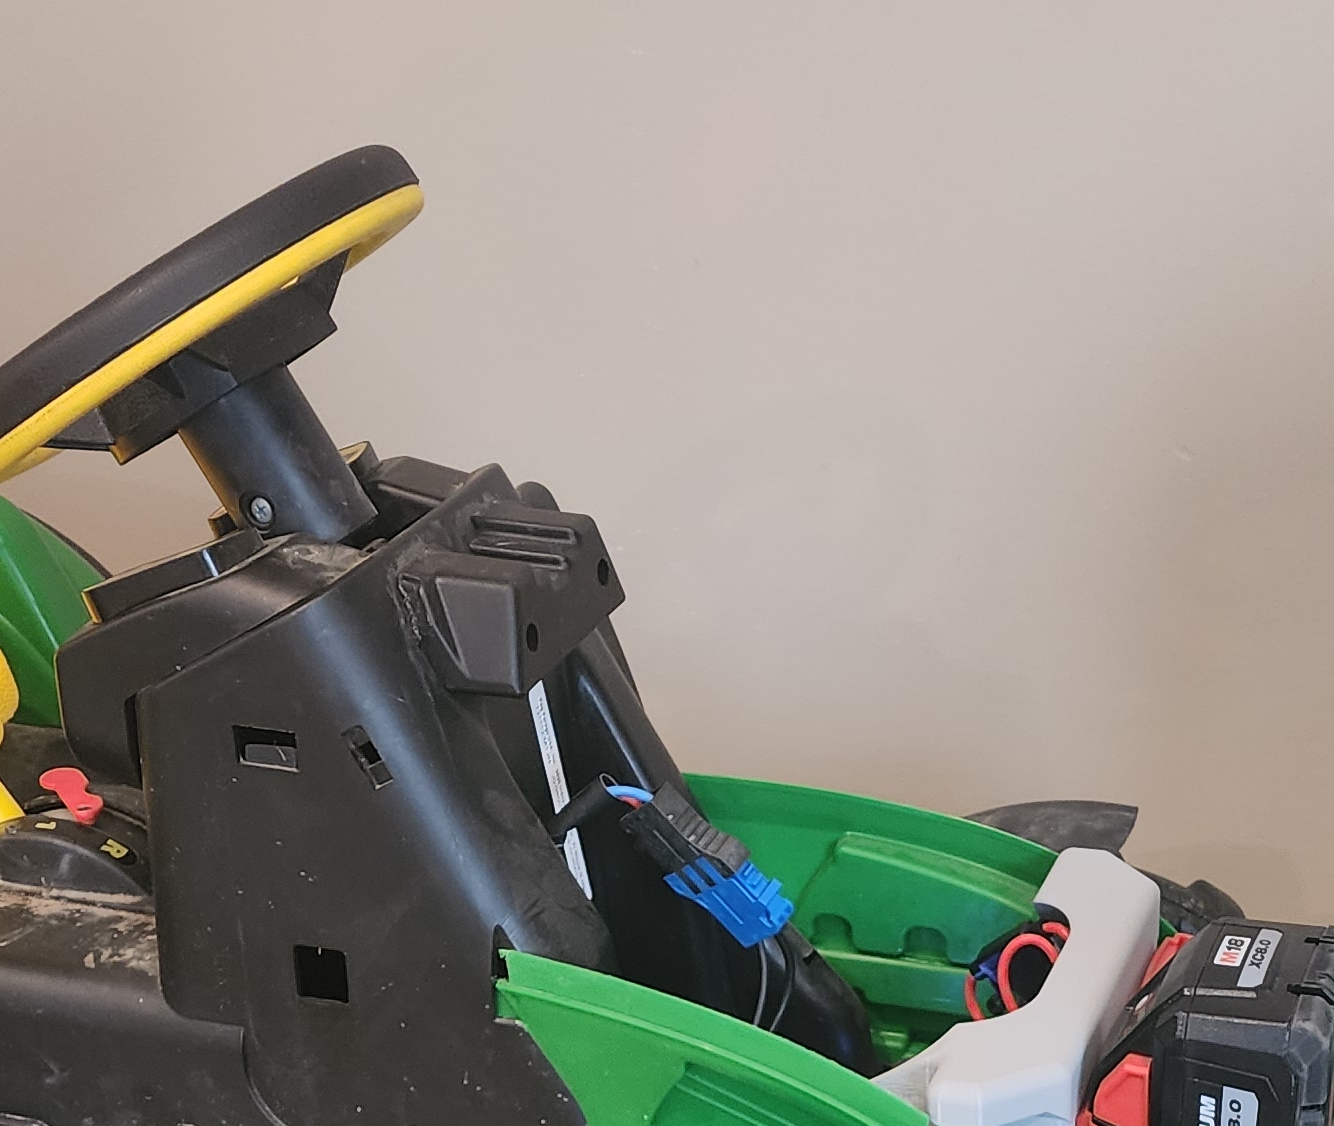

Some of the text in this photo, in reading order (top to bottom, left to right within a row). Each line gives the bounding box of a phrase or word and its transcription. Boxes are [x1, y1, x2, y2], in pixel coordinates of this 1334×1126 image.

[99, 837, 130, 859] R
[1219, 937, 1245, 964] M18
[1248, 939, 1272, 970] XC8.0
